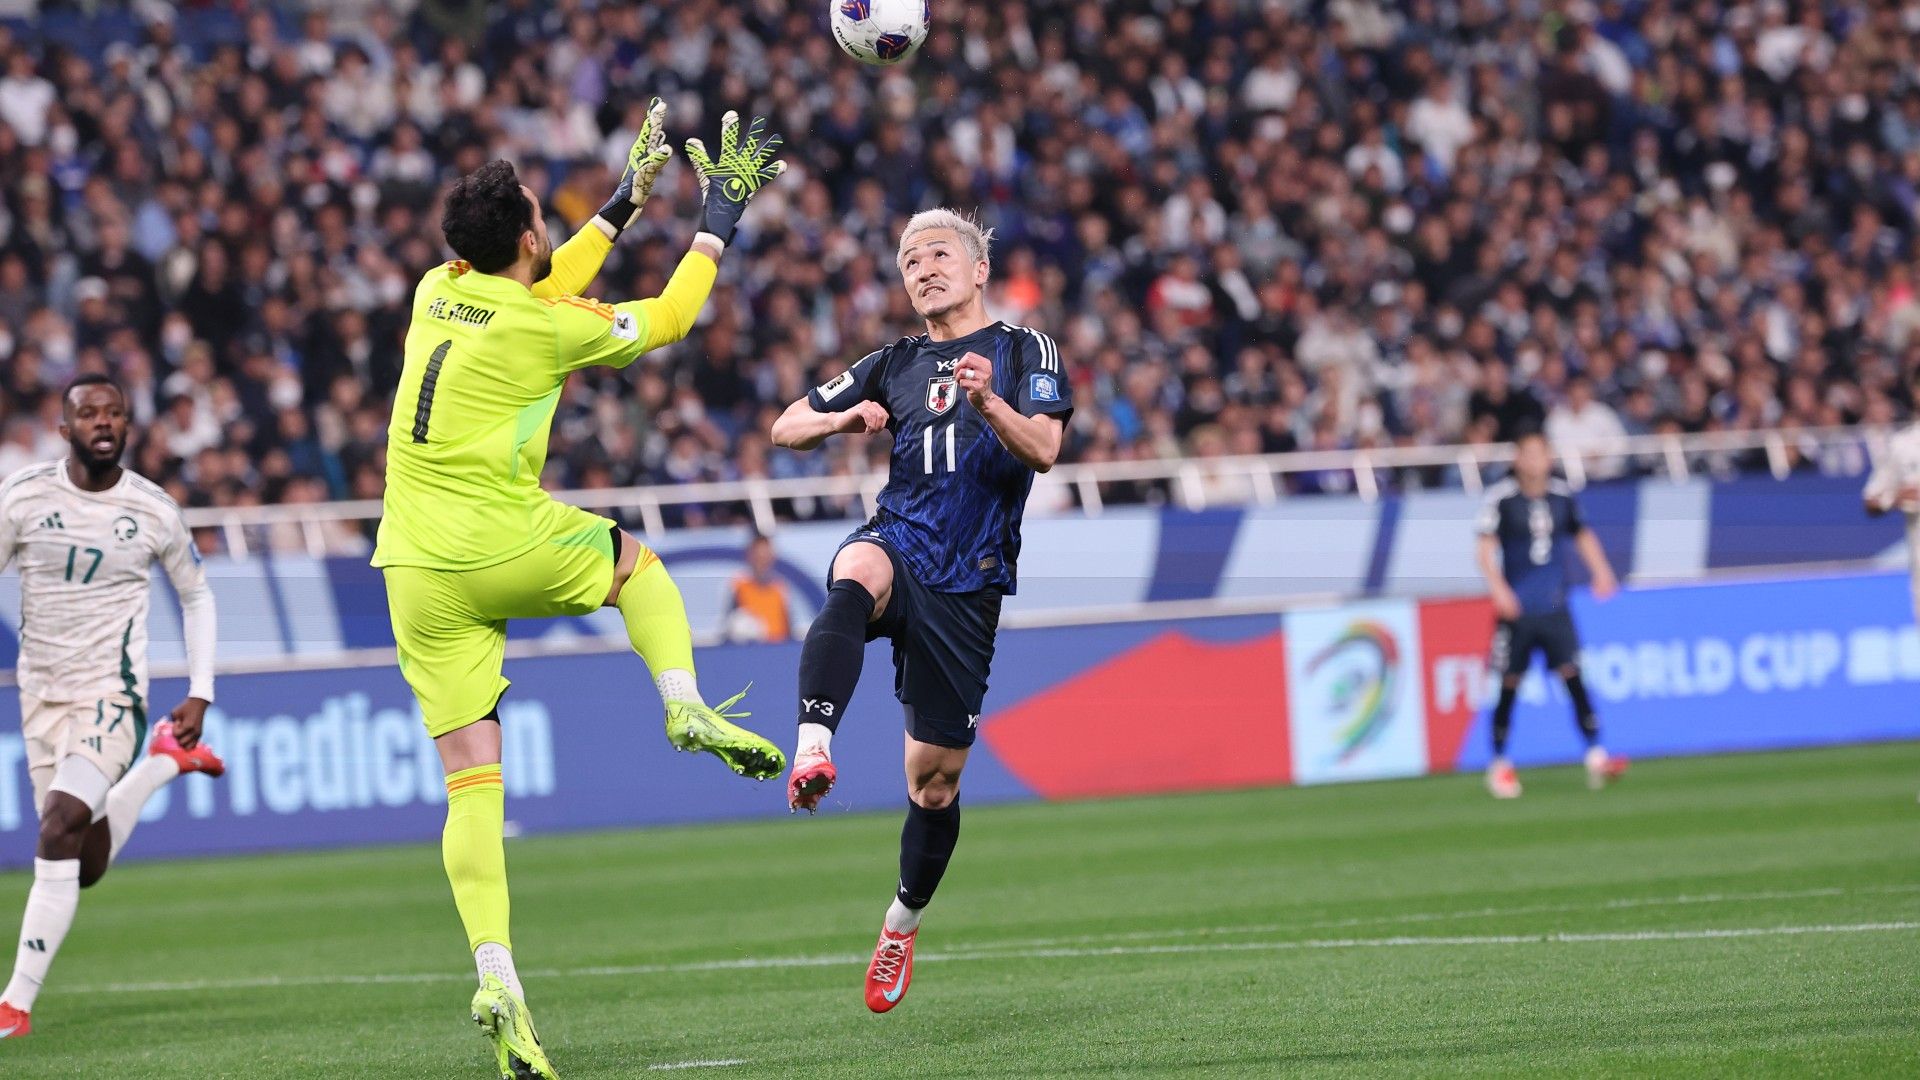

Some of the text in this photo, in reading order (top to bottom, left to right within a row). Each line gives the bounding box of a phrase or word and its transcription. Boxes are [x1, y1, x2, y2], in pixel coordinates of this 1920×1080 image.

[835, 26, 863, 58] molten
[412, 339, 452, 444] 1
[923, 422, 956, 475] 11
[65, 545, 103, 584] 17
[1739, 629, 1841, 693] CUP
[95, 699, 125, 733] 17
[802, 698, 834, 716] Y-3
